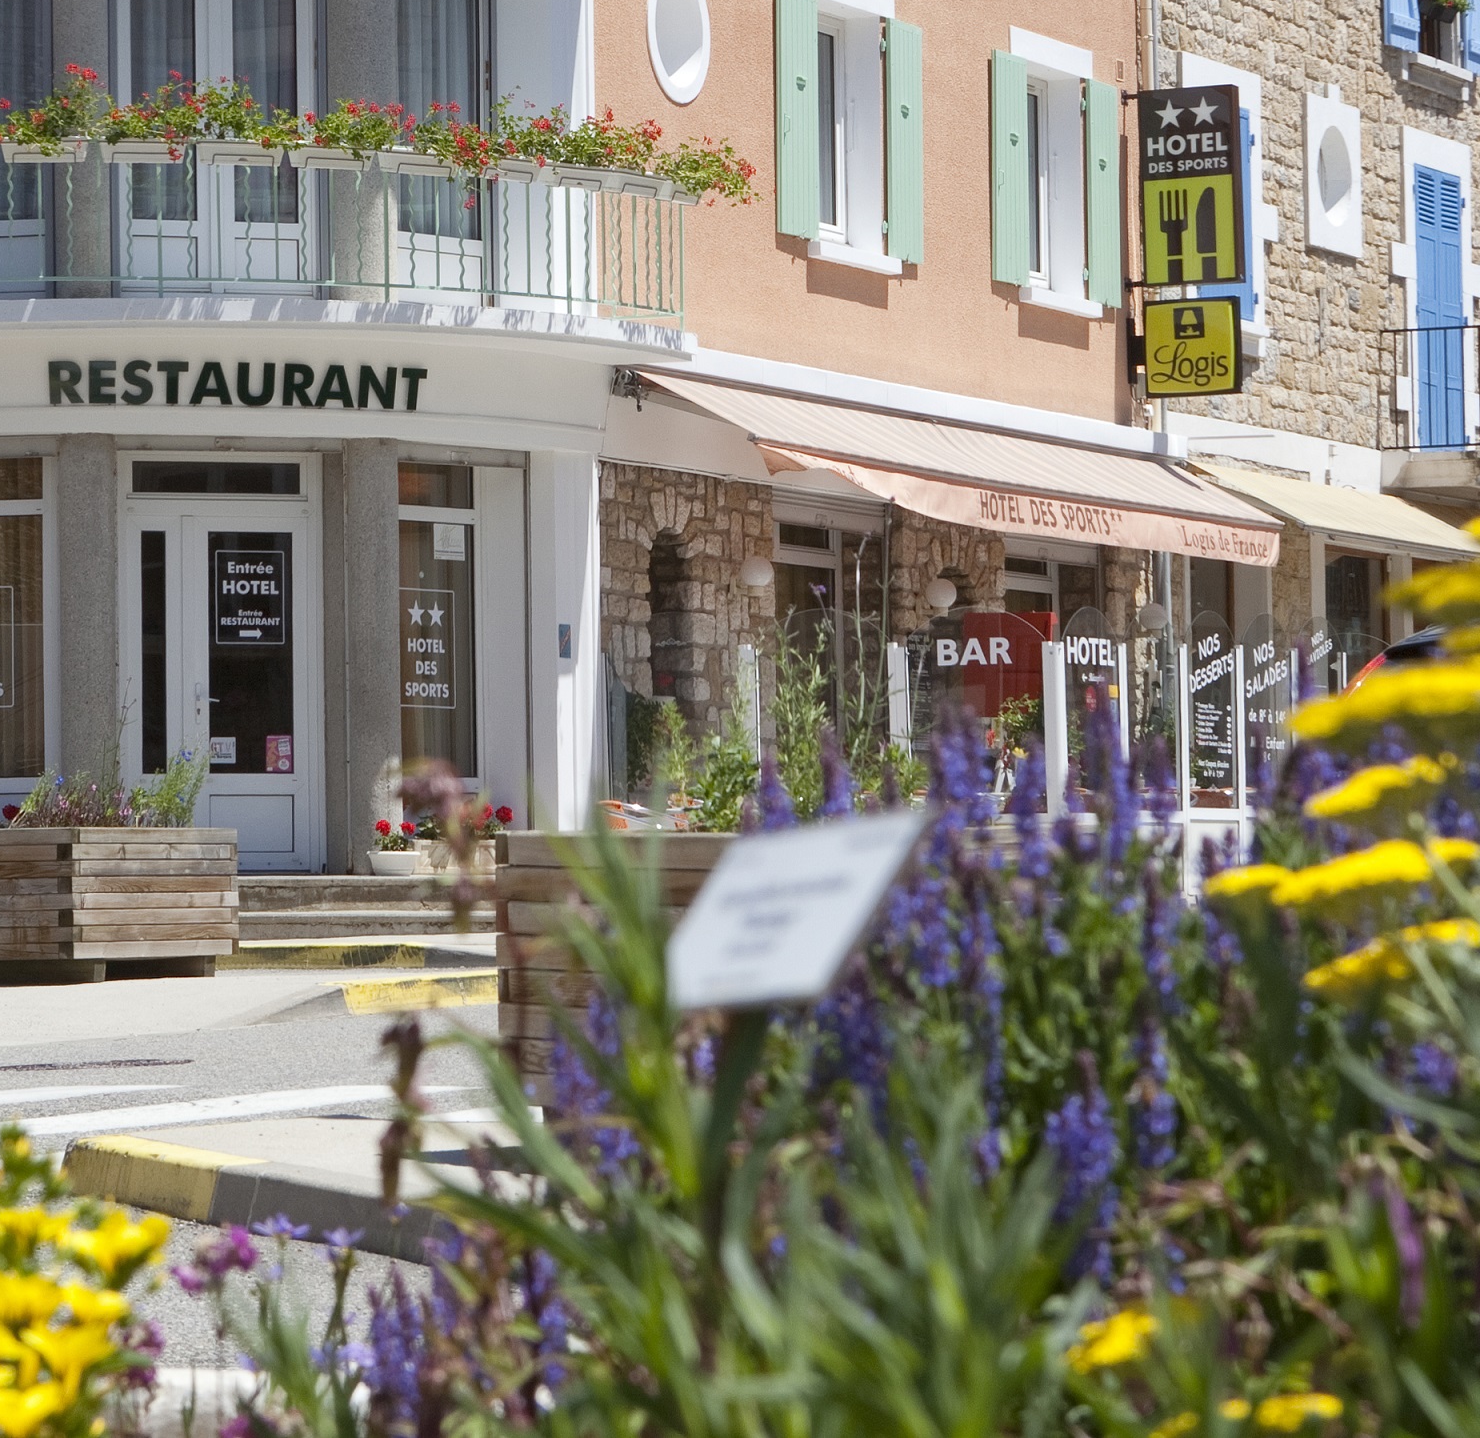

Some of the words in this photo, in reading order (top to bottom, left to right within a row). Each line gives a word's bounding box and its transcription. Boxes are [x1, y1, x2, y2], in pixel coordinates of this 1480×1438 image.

[1146, 132, 1228, 158] HOTEL
[1148, 162, 1174, 174] DES
[1177, 157, 1228, 172] SPORTS
[1149, 341, 1229, 387] Logis
[48, 360, 428, 412] RESTAURANT
[980, 490, 1025, 524] HOTEL
[1029, 498, 1057, 528] DES
[1060, 502, 1111, 536] SPORTS
[1181, 525, 1216, 556] Logis
[1218, 529, 1231, 552] de
[1231, 532, 1268, 558] France
[227, 562, 274, 574] Entrée
[222, 580, 280, 595] HOTEL
[220, 617, 281, 626] RESTAURANT
[238, 609, 263, 617] Entrée
[407, 637, 446, 654] HOTEL
[1198, 633, 1220, 661] NOS
[1311, 629, 1324, 648] NOS
[936, 636, 1013, 667] BAR
[1066, 635, 1116, 667] HOTEL
[1253, 640, 1275, 667] NOS
[415, 660, 438, 676] DES
[1189, 652, 1234, 694] DESSERTS
[1246, 659, 1288, 698] SALADES
[405, 682, 450, 698] SPORTS
[1248, 707, 1257, 722] de
[1267, 708, 1273, 724] à
[1265, 736, 1286, 750] Enfant
